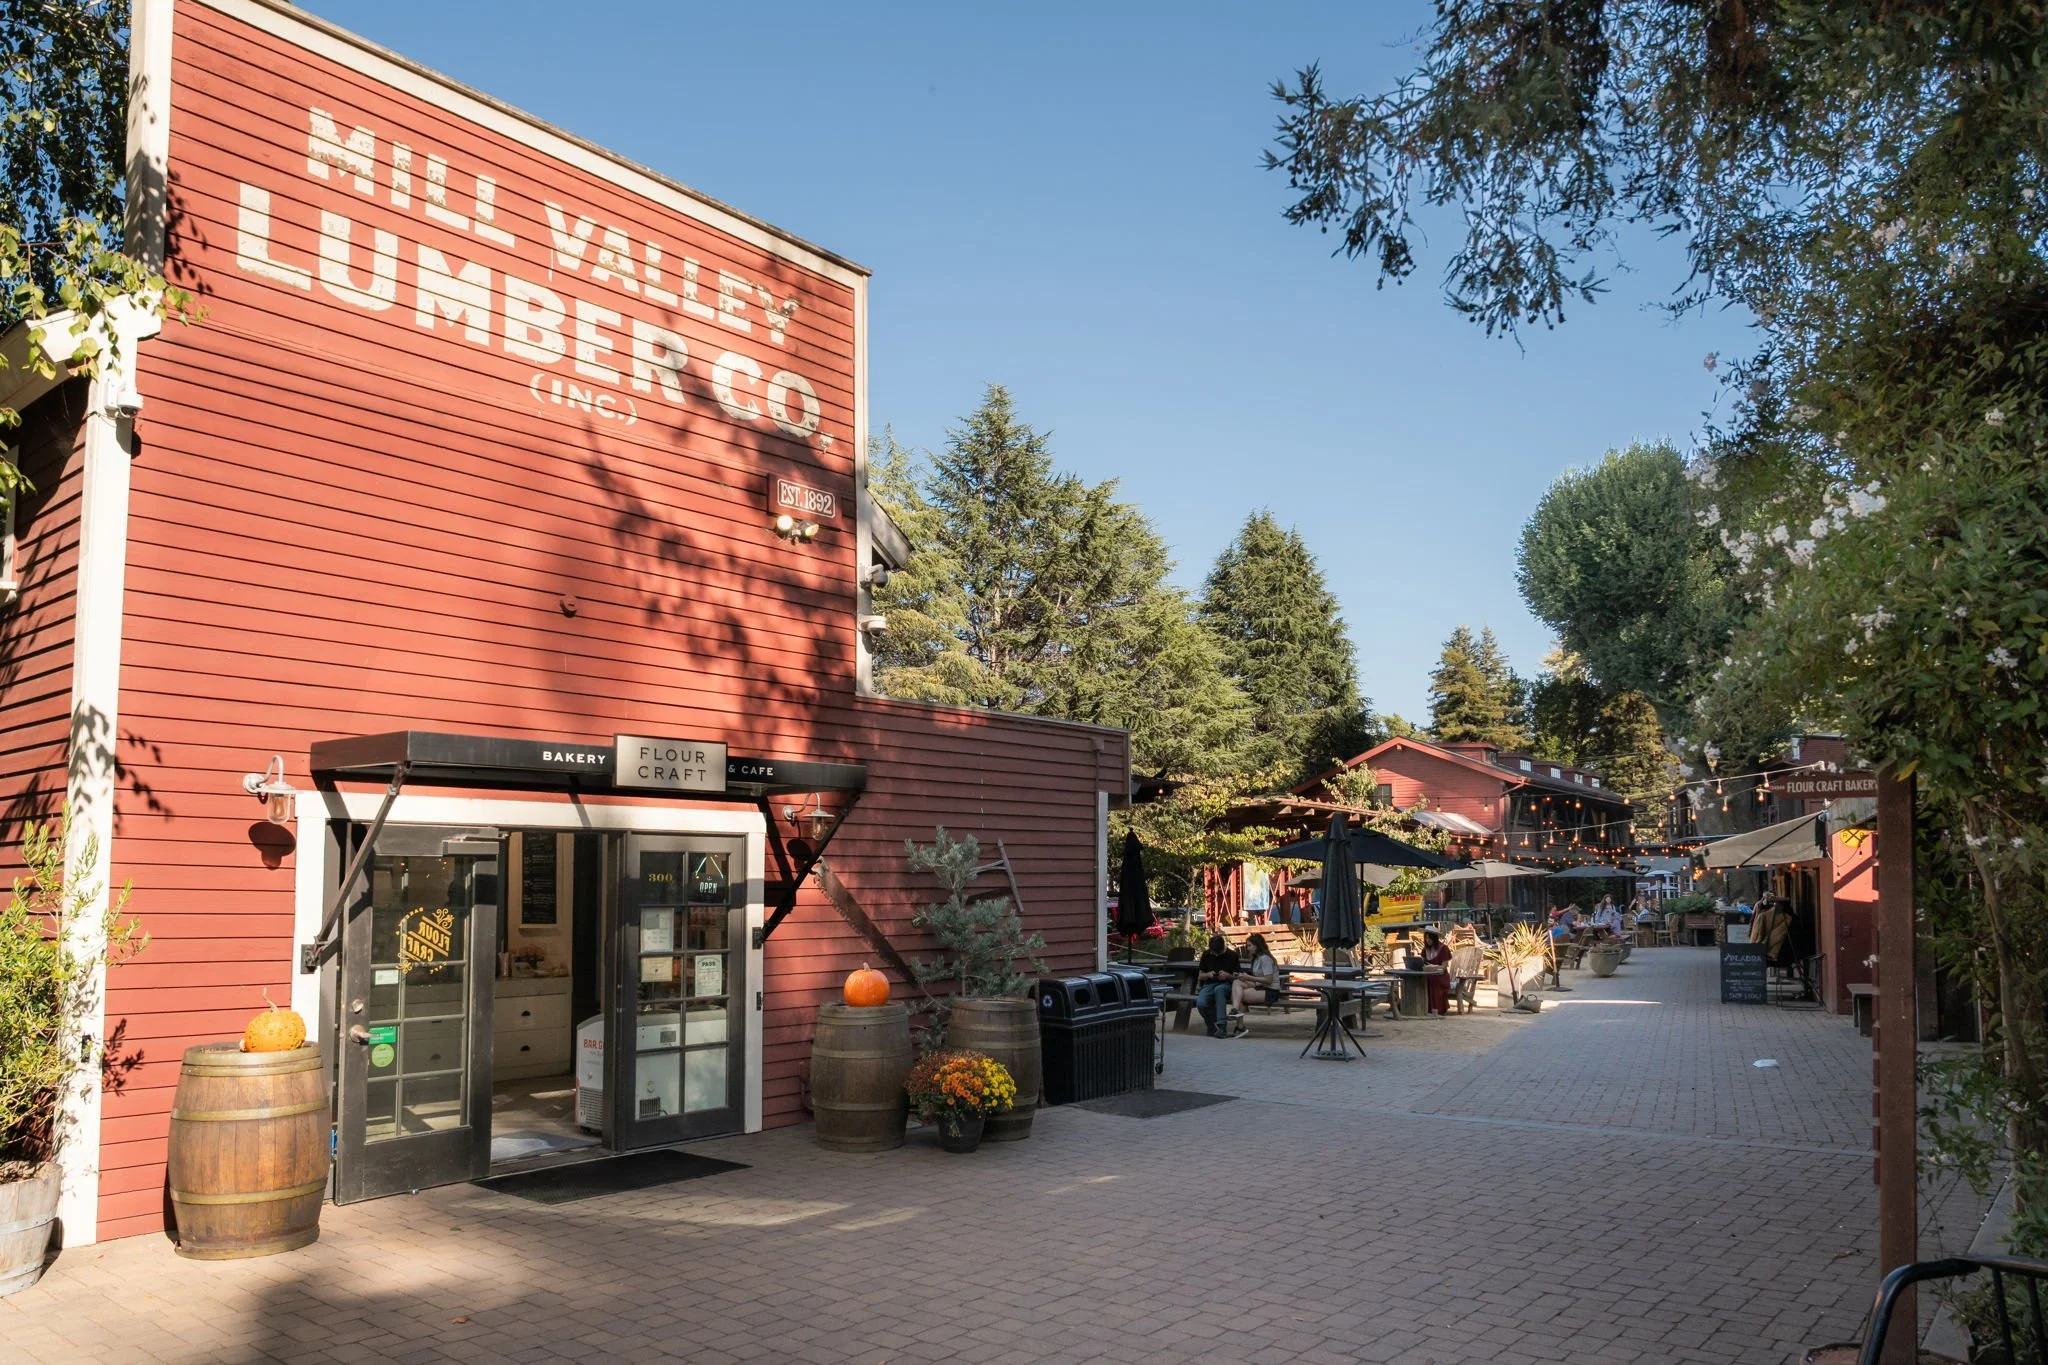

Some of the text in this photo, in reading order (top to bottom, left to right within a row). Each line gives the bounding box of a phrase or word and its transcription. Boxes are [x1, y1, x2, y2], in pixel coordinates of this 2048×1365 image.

[307, 106, 802, 345] MILL VALLEY
[236, 182, 835, 453] LUMBER CO.
[529, 373, 639, 426] (INC.)
[780, 482, 834, 515] EST. 1892
[542, 751, 606, 765] BAKERY
[639, 746, 706, 764] FLOUR
[637, 765, 707, 782] CRAFT
[728, 764, 774, 776] & CAFE
[1786, 781, 1815, 793] FLOUR
[1816, 780, 1843, 792] CRAFT
[648, 873, 673, 883] 300
[699, 882, 718, 894] OPEN
